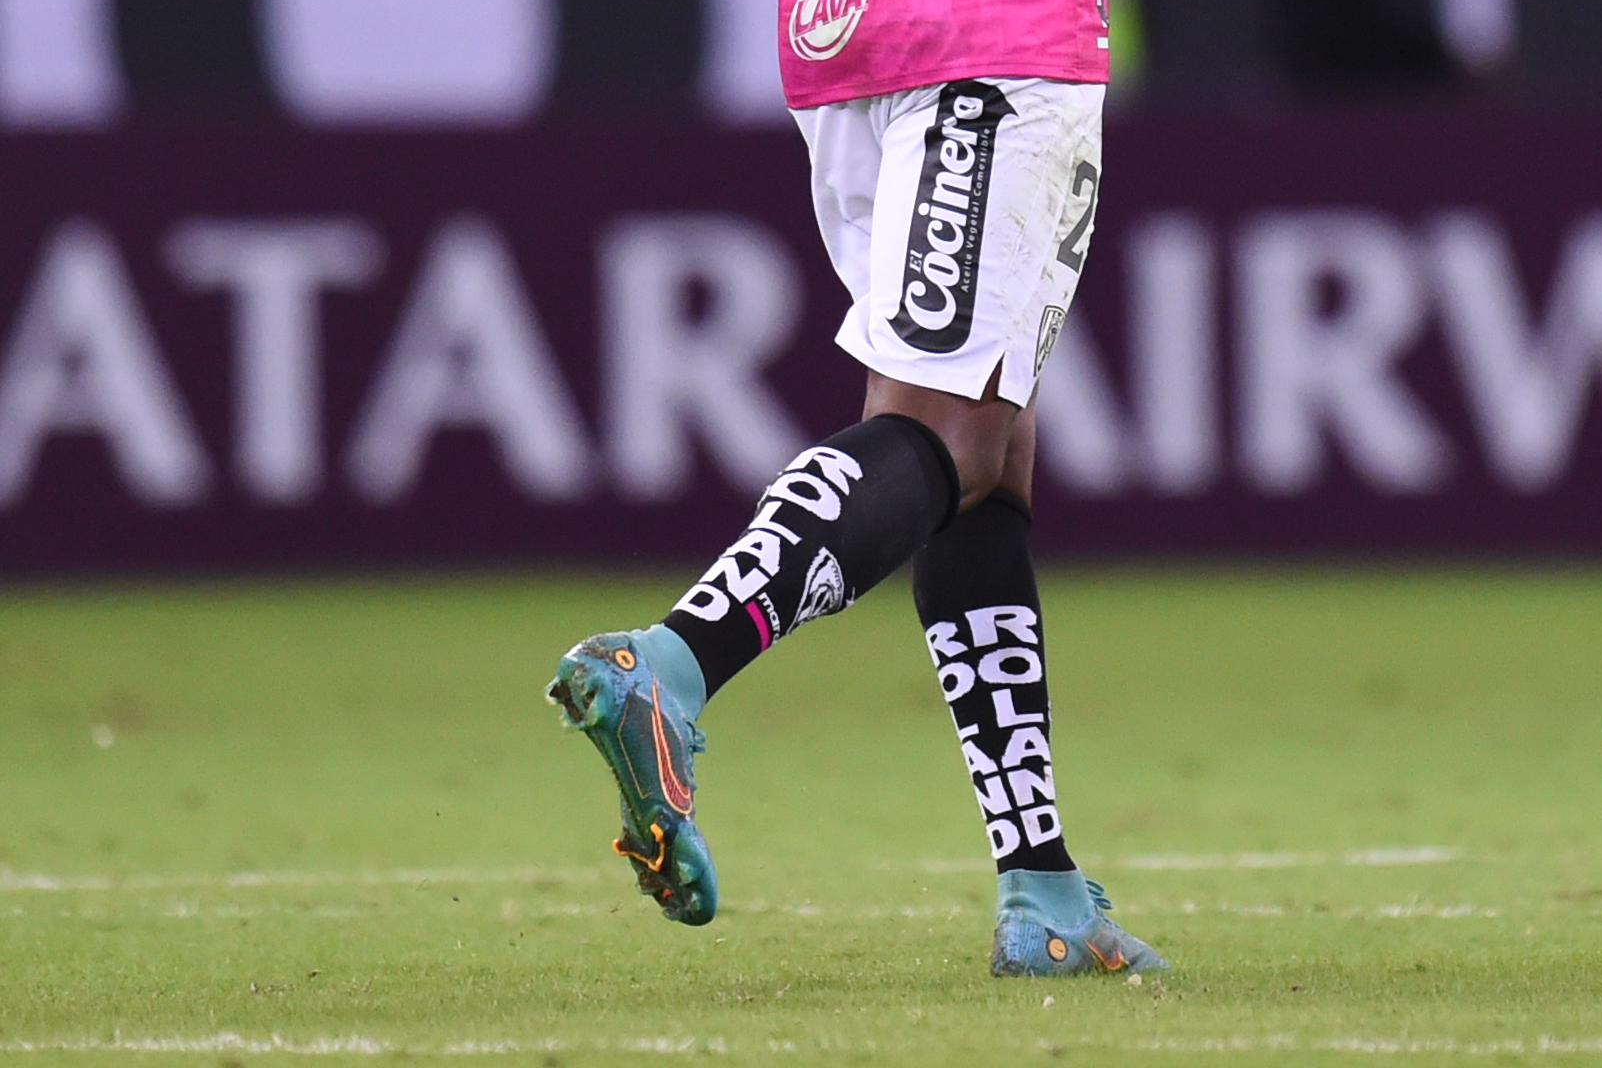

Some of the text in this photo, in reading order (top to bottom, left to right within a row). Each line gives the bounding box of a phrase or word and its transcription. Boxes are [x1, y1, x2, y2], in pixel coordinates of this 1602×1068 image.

[904, 95, 984, 331] Cocinero
[909, 249, 923, 274] El
[960, 127, 991, 293] Aceite Vegetal Comestible
[1056, 159, 1098, 274] 2
[671, 445, 864, 622] ROLAND
[925, 620, 1020, 861] ROLAND
[964, 605, 1063, 848] ROLAND
